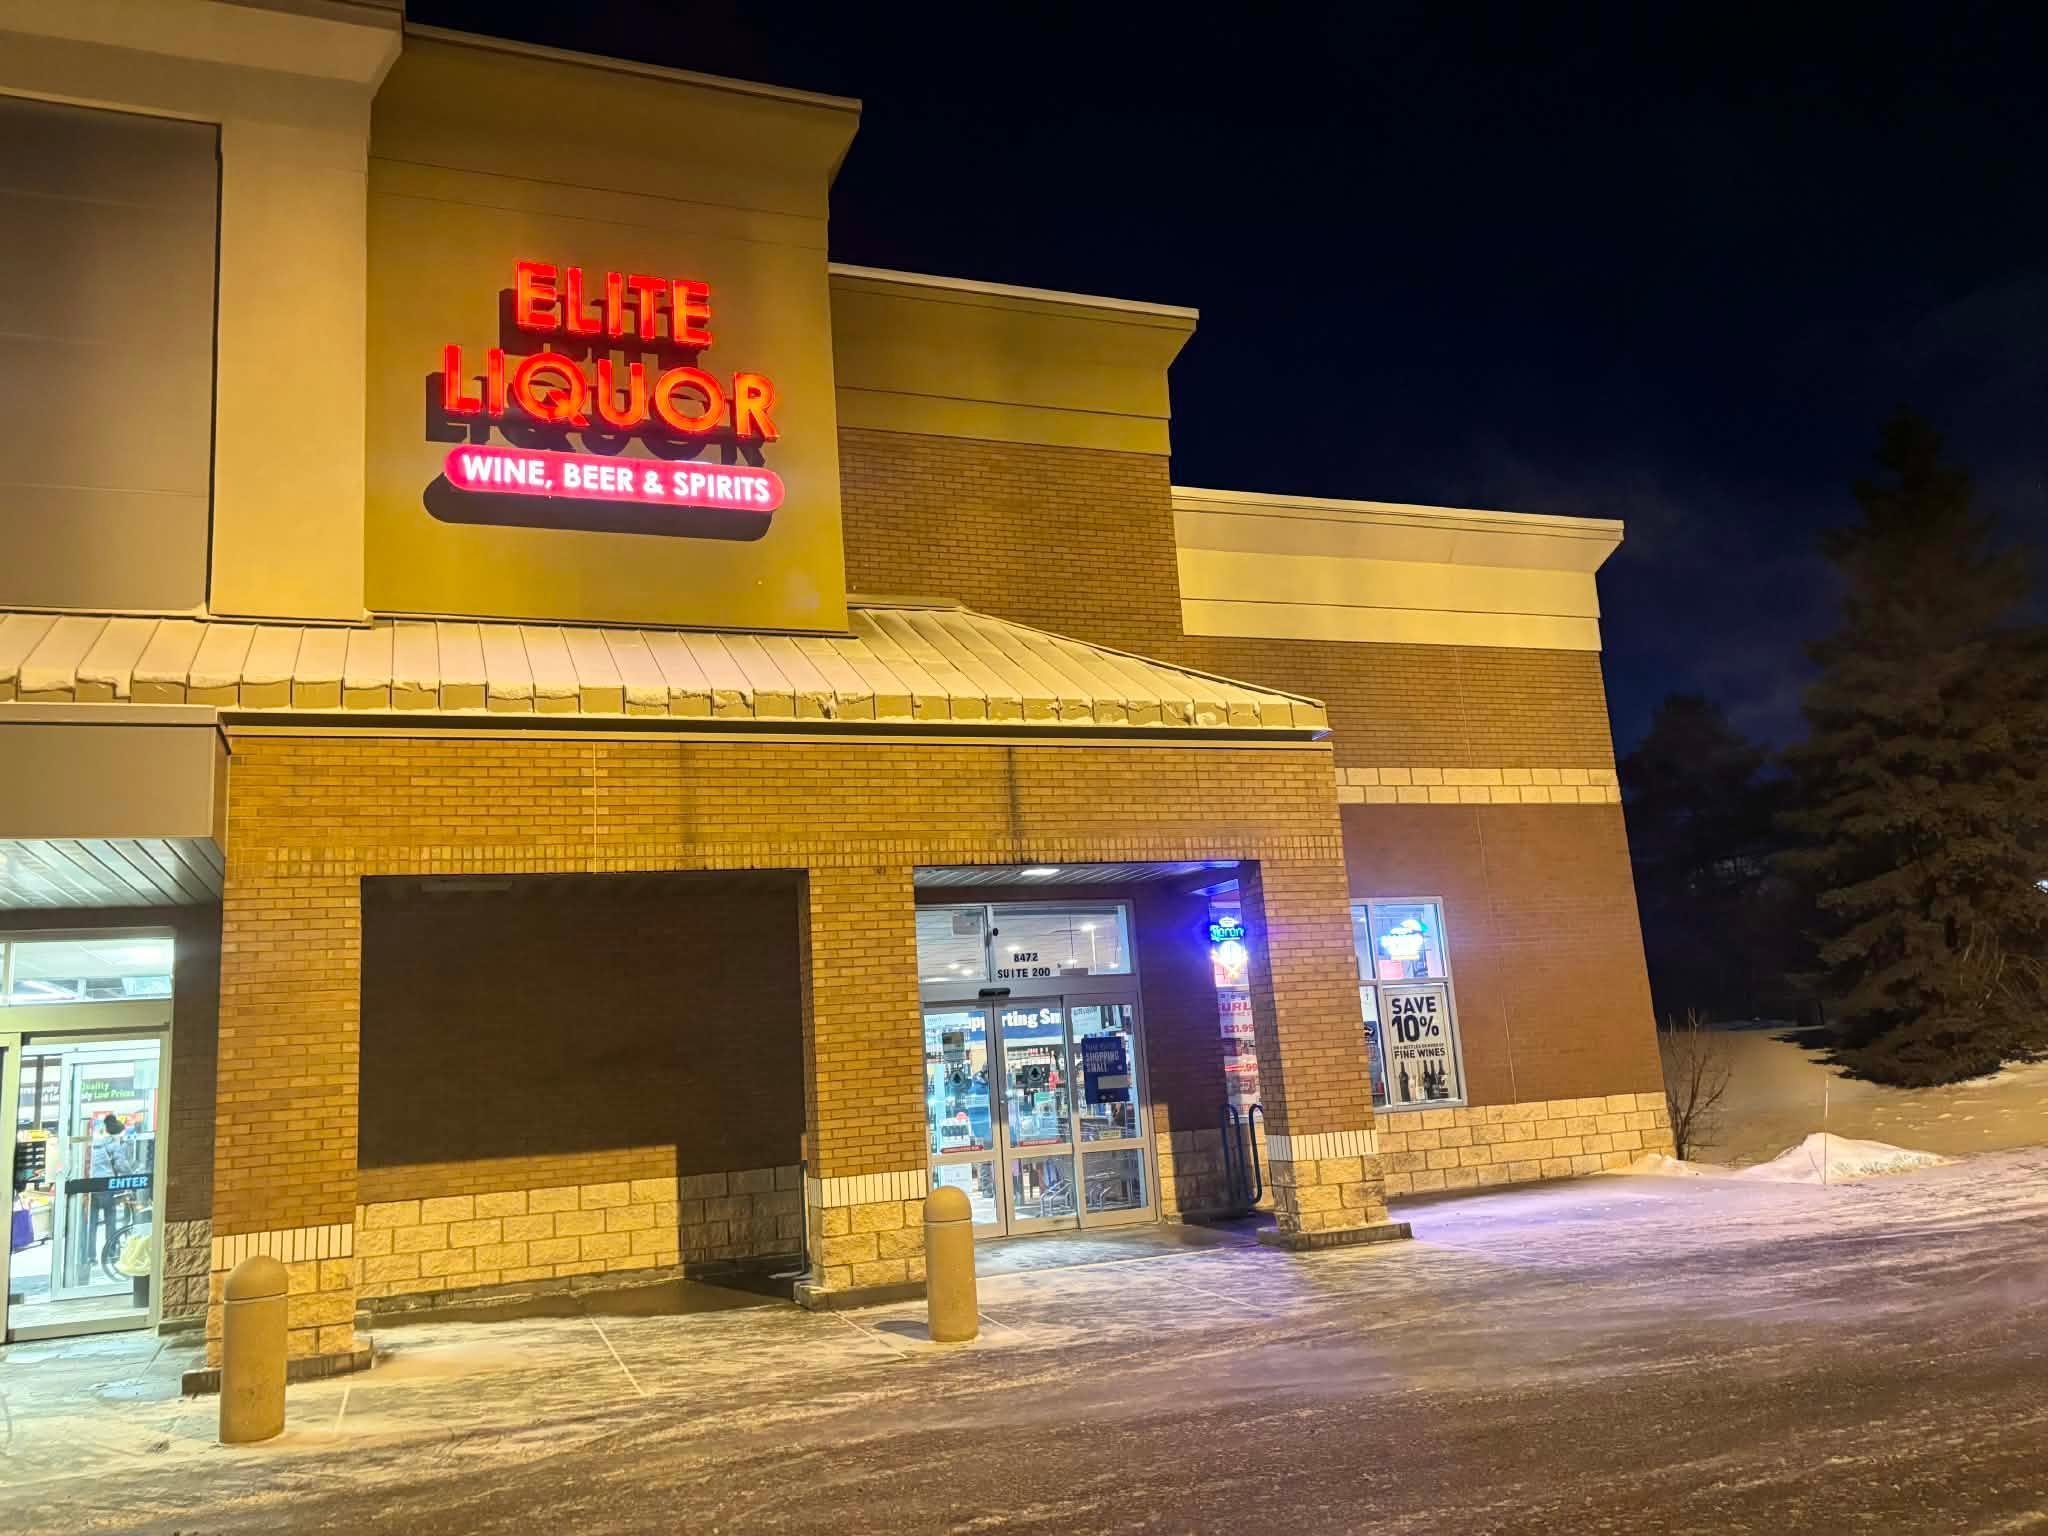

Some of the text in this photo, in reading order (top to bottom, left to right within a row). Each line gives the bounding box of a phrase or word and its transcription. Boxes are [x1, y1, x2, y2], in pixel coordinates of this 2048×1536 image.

[516, 261, 712, 345] ELITE
[443, 345, 781, 442] LIQUOR
[462, 454, 771, 502] WINE, BEER & SPIRITS
[1013, 953, 1038, 962] 8472
[997, 967, 1051, 978] SUITE 200
[1391, 996, 1436, 1015] SAVE
[1391, 1014, 1440, 1043] 10%
[1394, 1048, 1445, 1059] FINE WINES
[108, 1177, 149, 1189] ENTER
